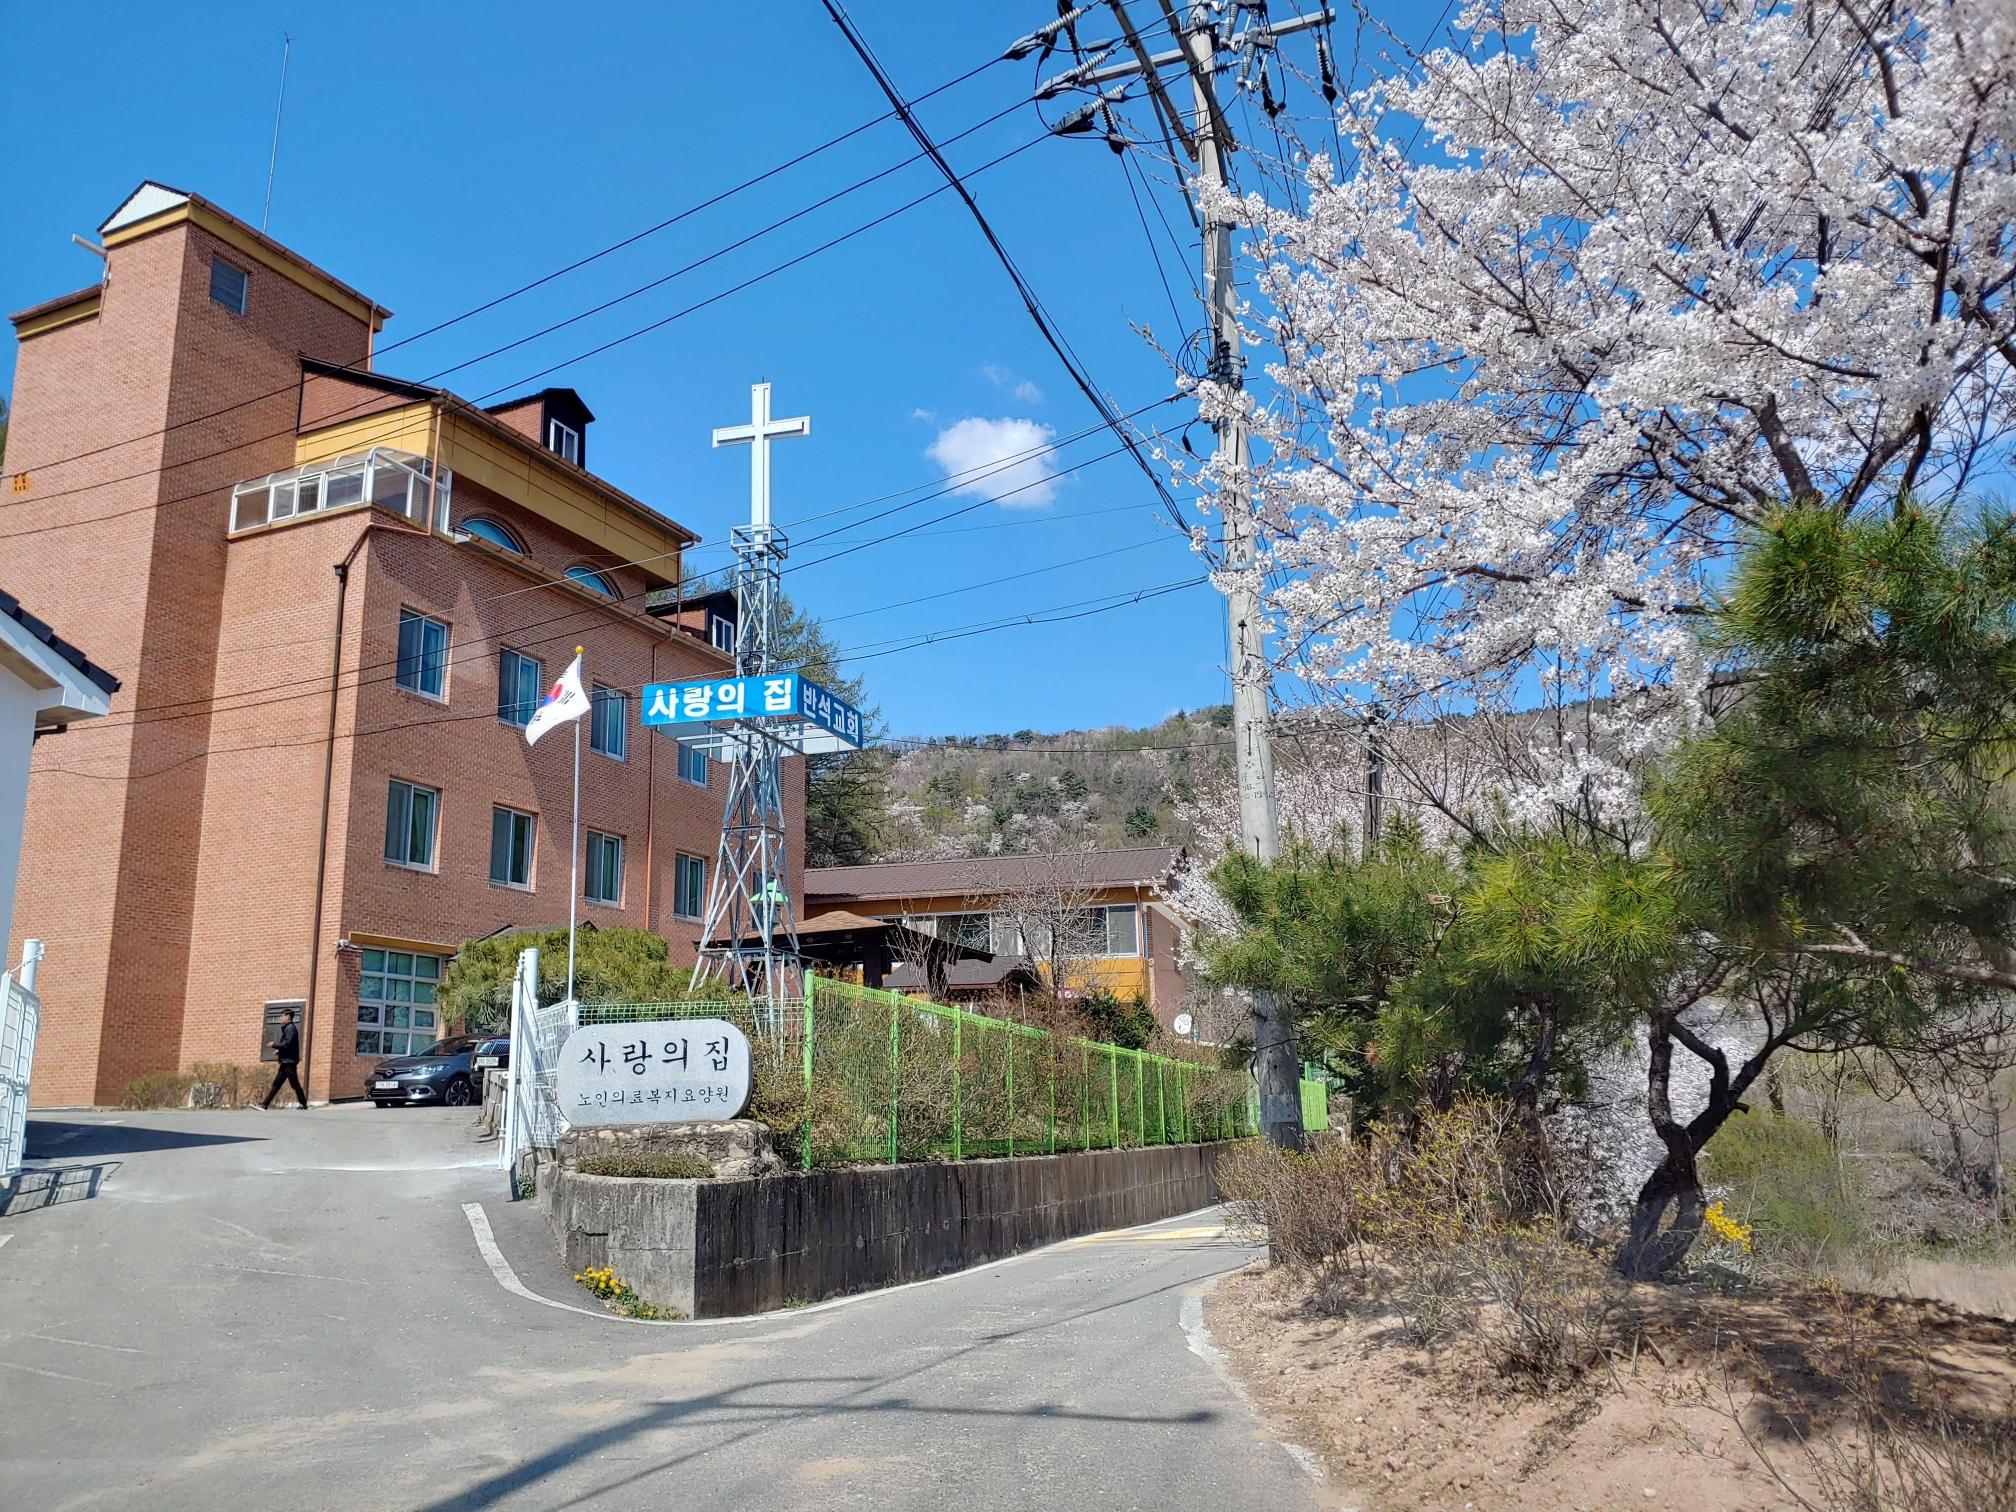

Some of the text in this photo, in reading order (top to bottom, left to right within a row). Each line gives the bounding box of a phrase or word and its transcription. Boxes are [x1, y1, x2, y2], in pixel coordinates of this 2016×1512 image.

[648, 677, 792, 720] 사랑의 집
[803, 684, 859, 743] 반석교회
[578, 1036, 729, 1076] 사랑의 집
